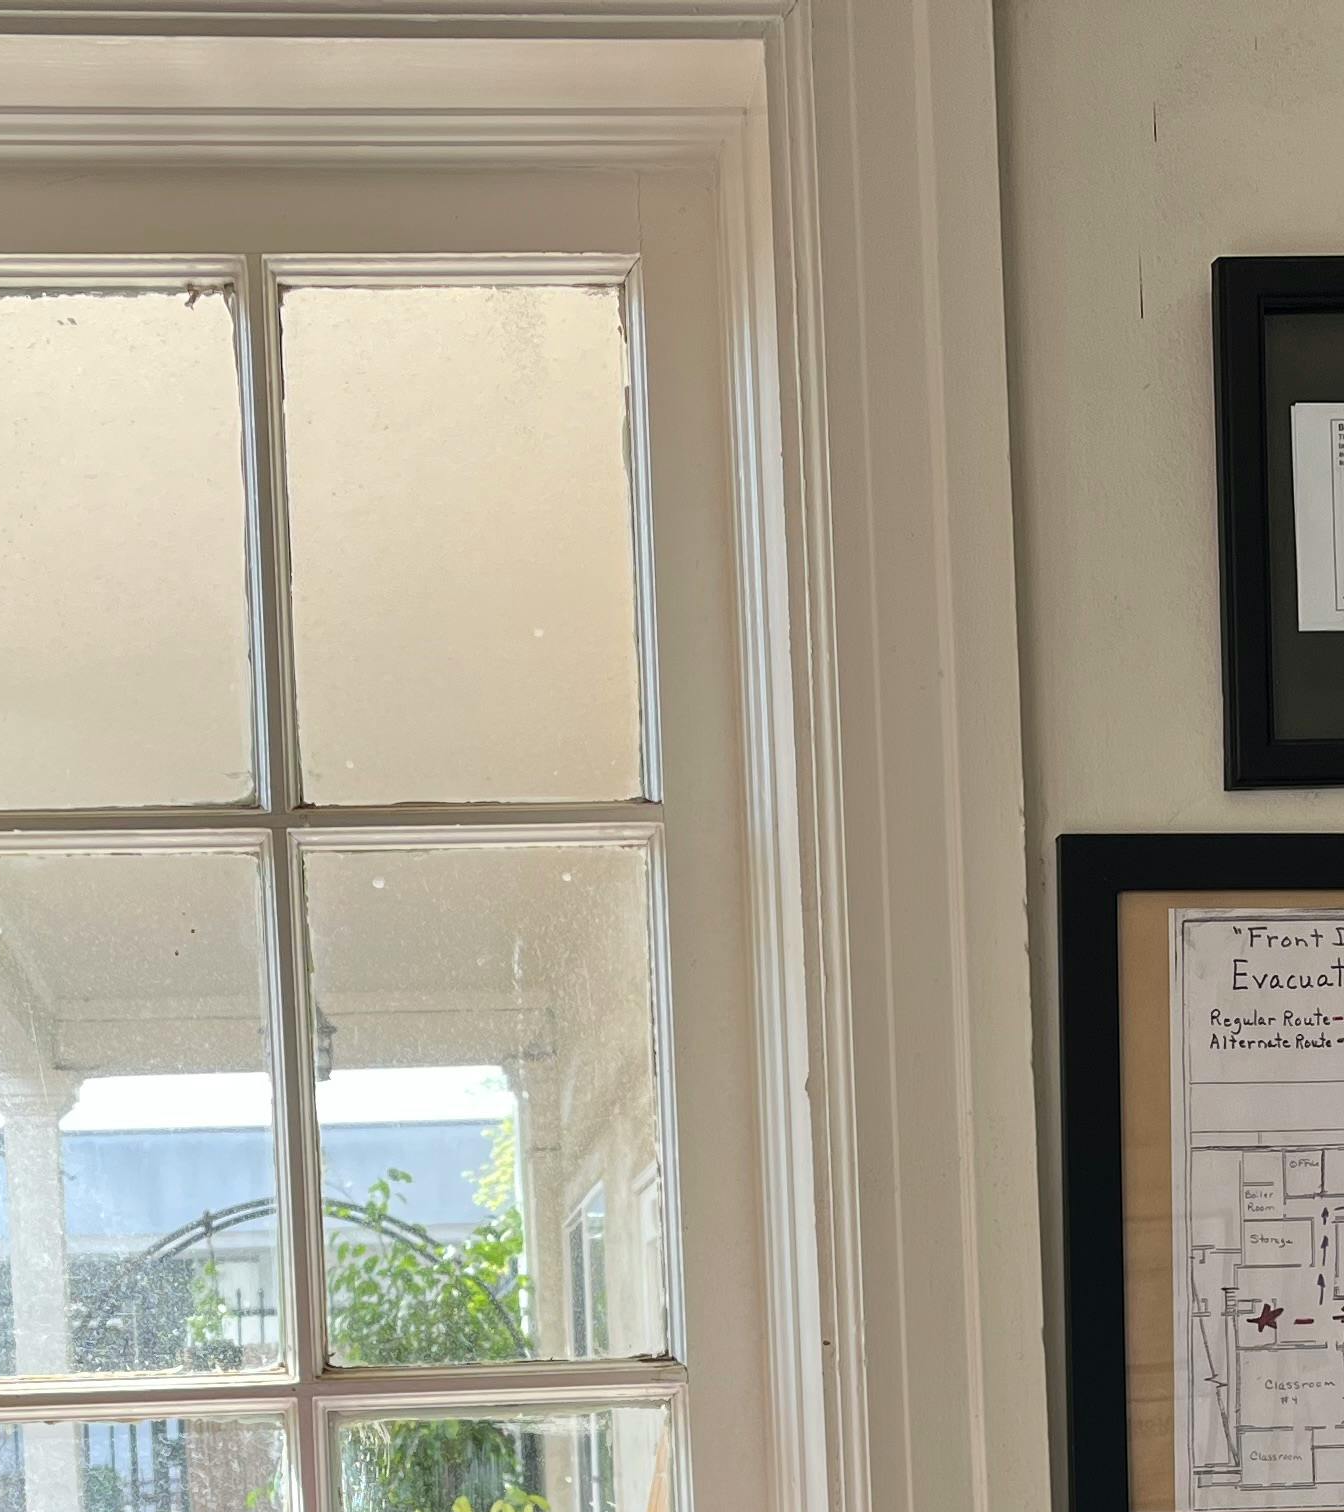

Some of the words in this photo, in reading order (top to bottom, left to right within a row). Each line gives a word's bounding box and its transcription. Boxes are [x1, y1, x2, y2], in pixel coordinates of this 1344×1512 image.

[1209, 1008, 1276, 1035] Regular
[1282, 1007, 1331, 1028] Route
[1209, 1032, 1291, 1050] Alternate
[1295, 1031, 1332, 1050] Route
[1247, 1203, 1275, 1212] Room
[1249, 1234, 1294, 1248] Storage
[1264, 1379, 1336, 1390] Classroom
